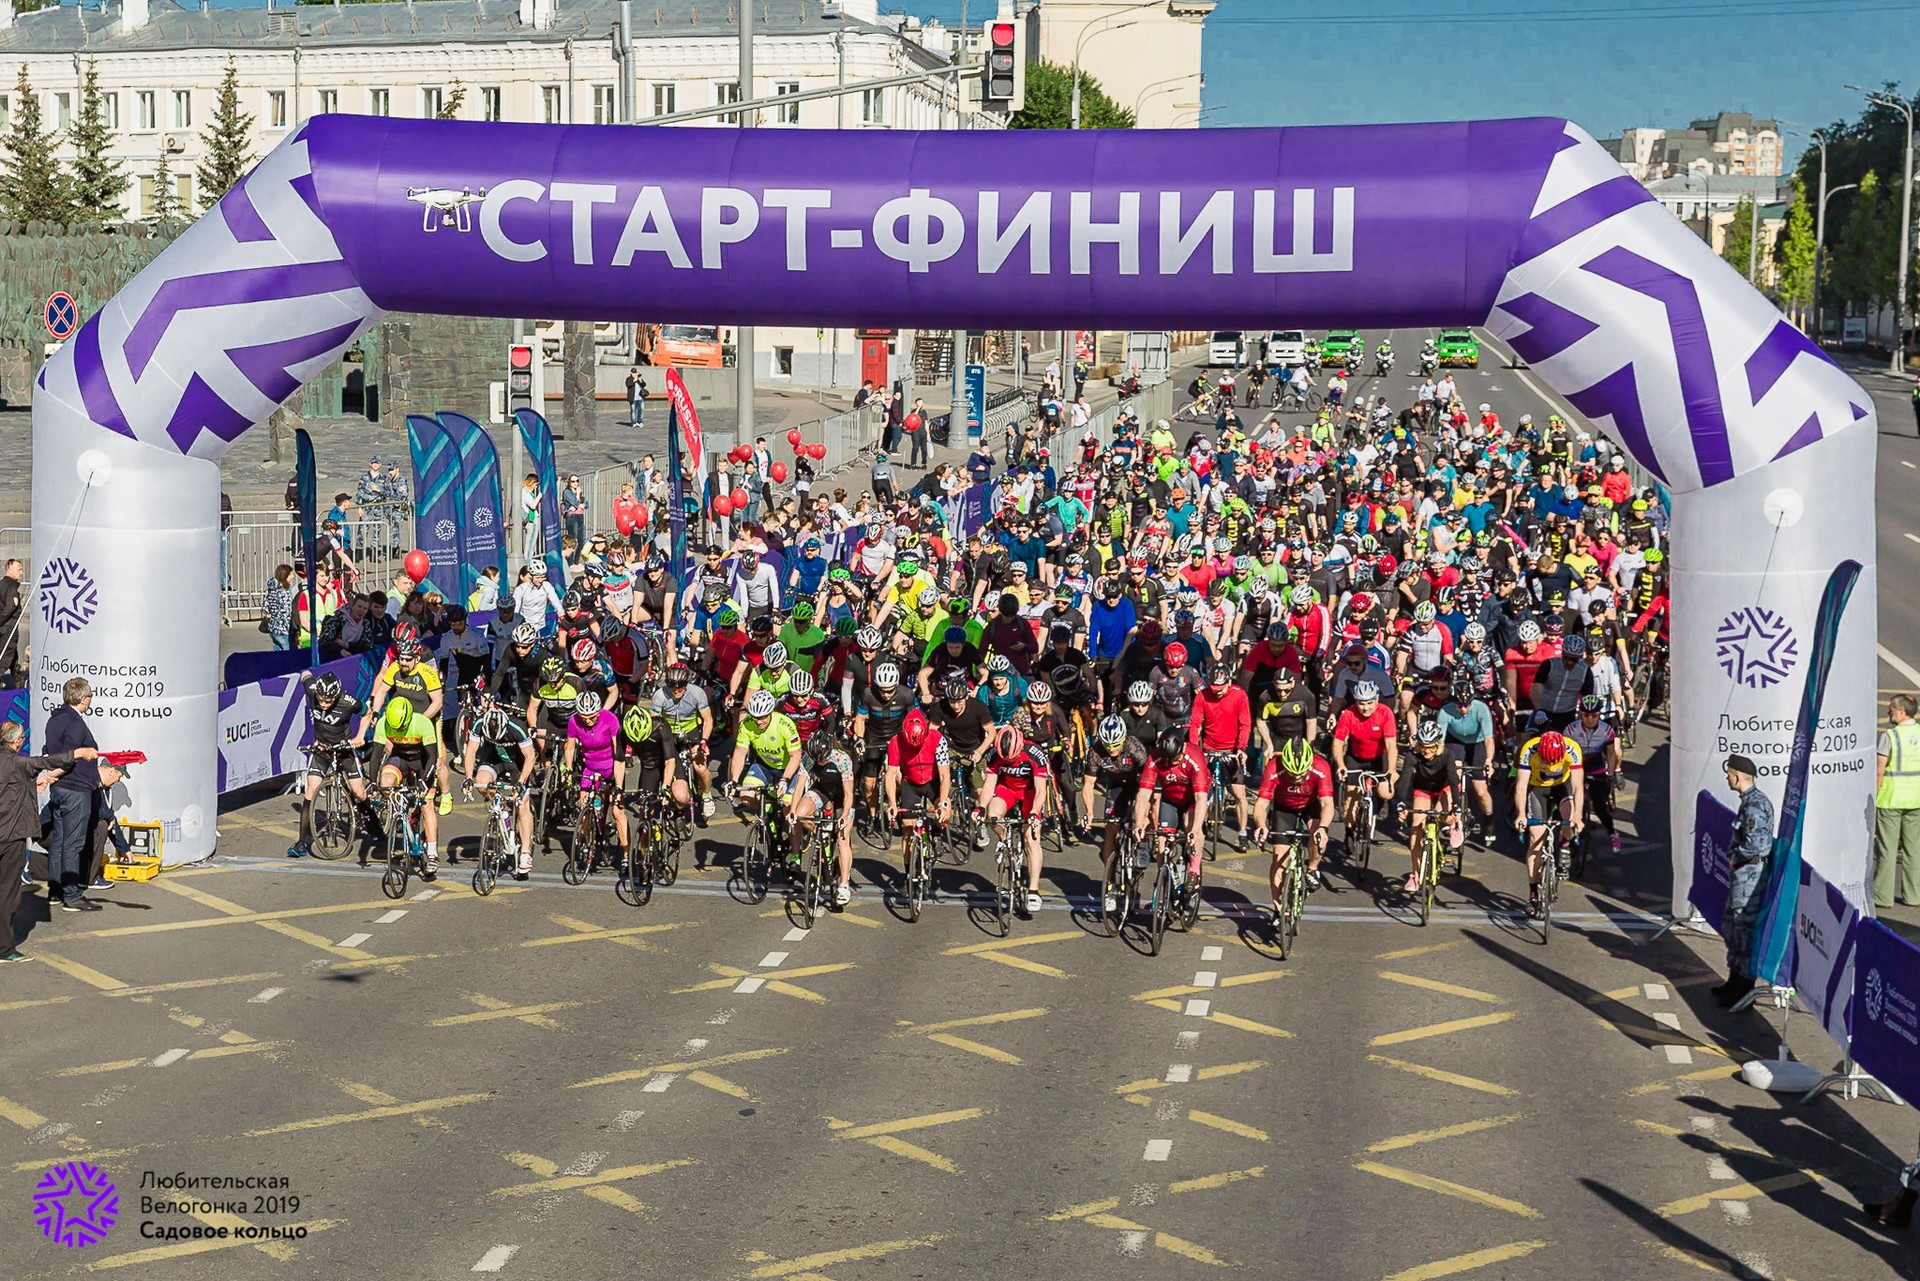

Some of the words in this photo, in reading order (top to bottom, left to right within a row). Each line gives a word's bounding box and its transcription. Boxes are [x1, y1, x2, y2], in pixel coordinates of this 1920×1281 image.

[480, 180, 1355, 274] СТАРТ-ФИНИШ
[41, 655, 157, 676] Любительская
[41, 676, 118, 698] Велнка
[124, 682, 164, 698] 2019
[110, 706, 172, 719] кольцо
[1718, 714, 1851, 732] Любитеская
[231, 721, 250, 742] UCI
[1718, 736, 1817, 754] Велогона
[1823, 733, 1857, 752] 2019
[1028, 745, 1047, 766] BMC
[1811, 758, 1864, 776] кольцо
